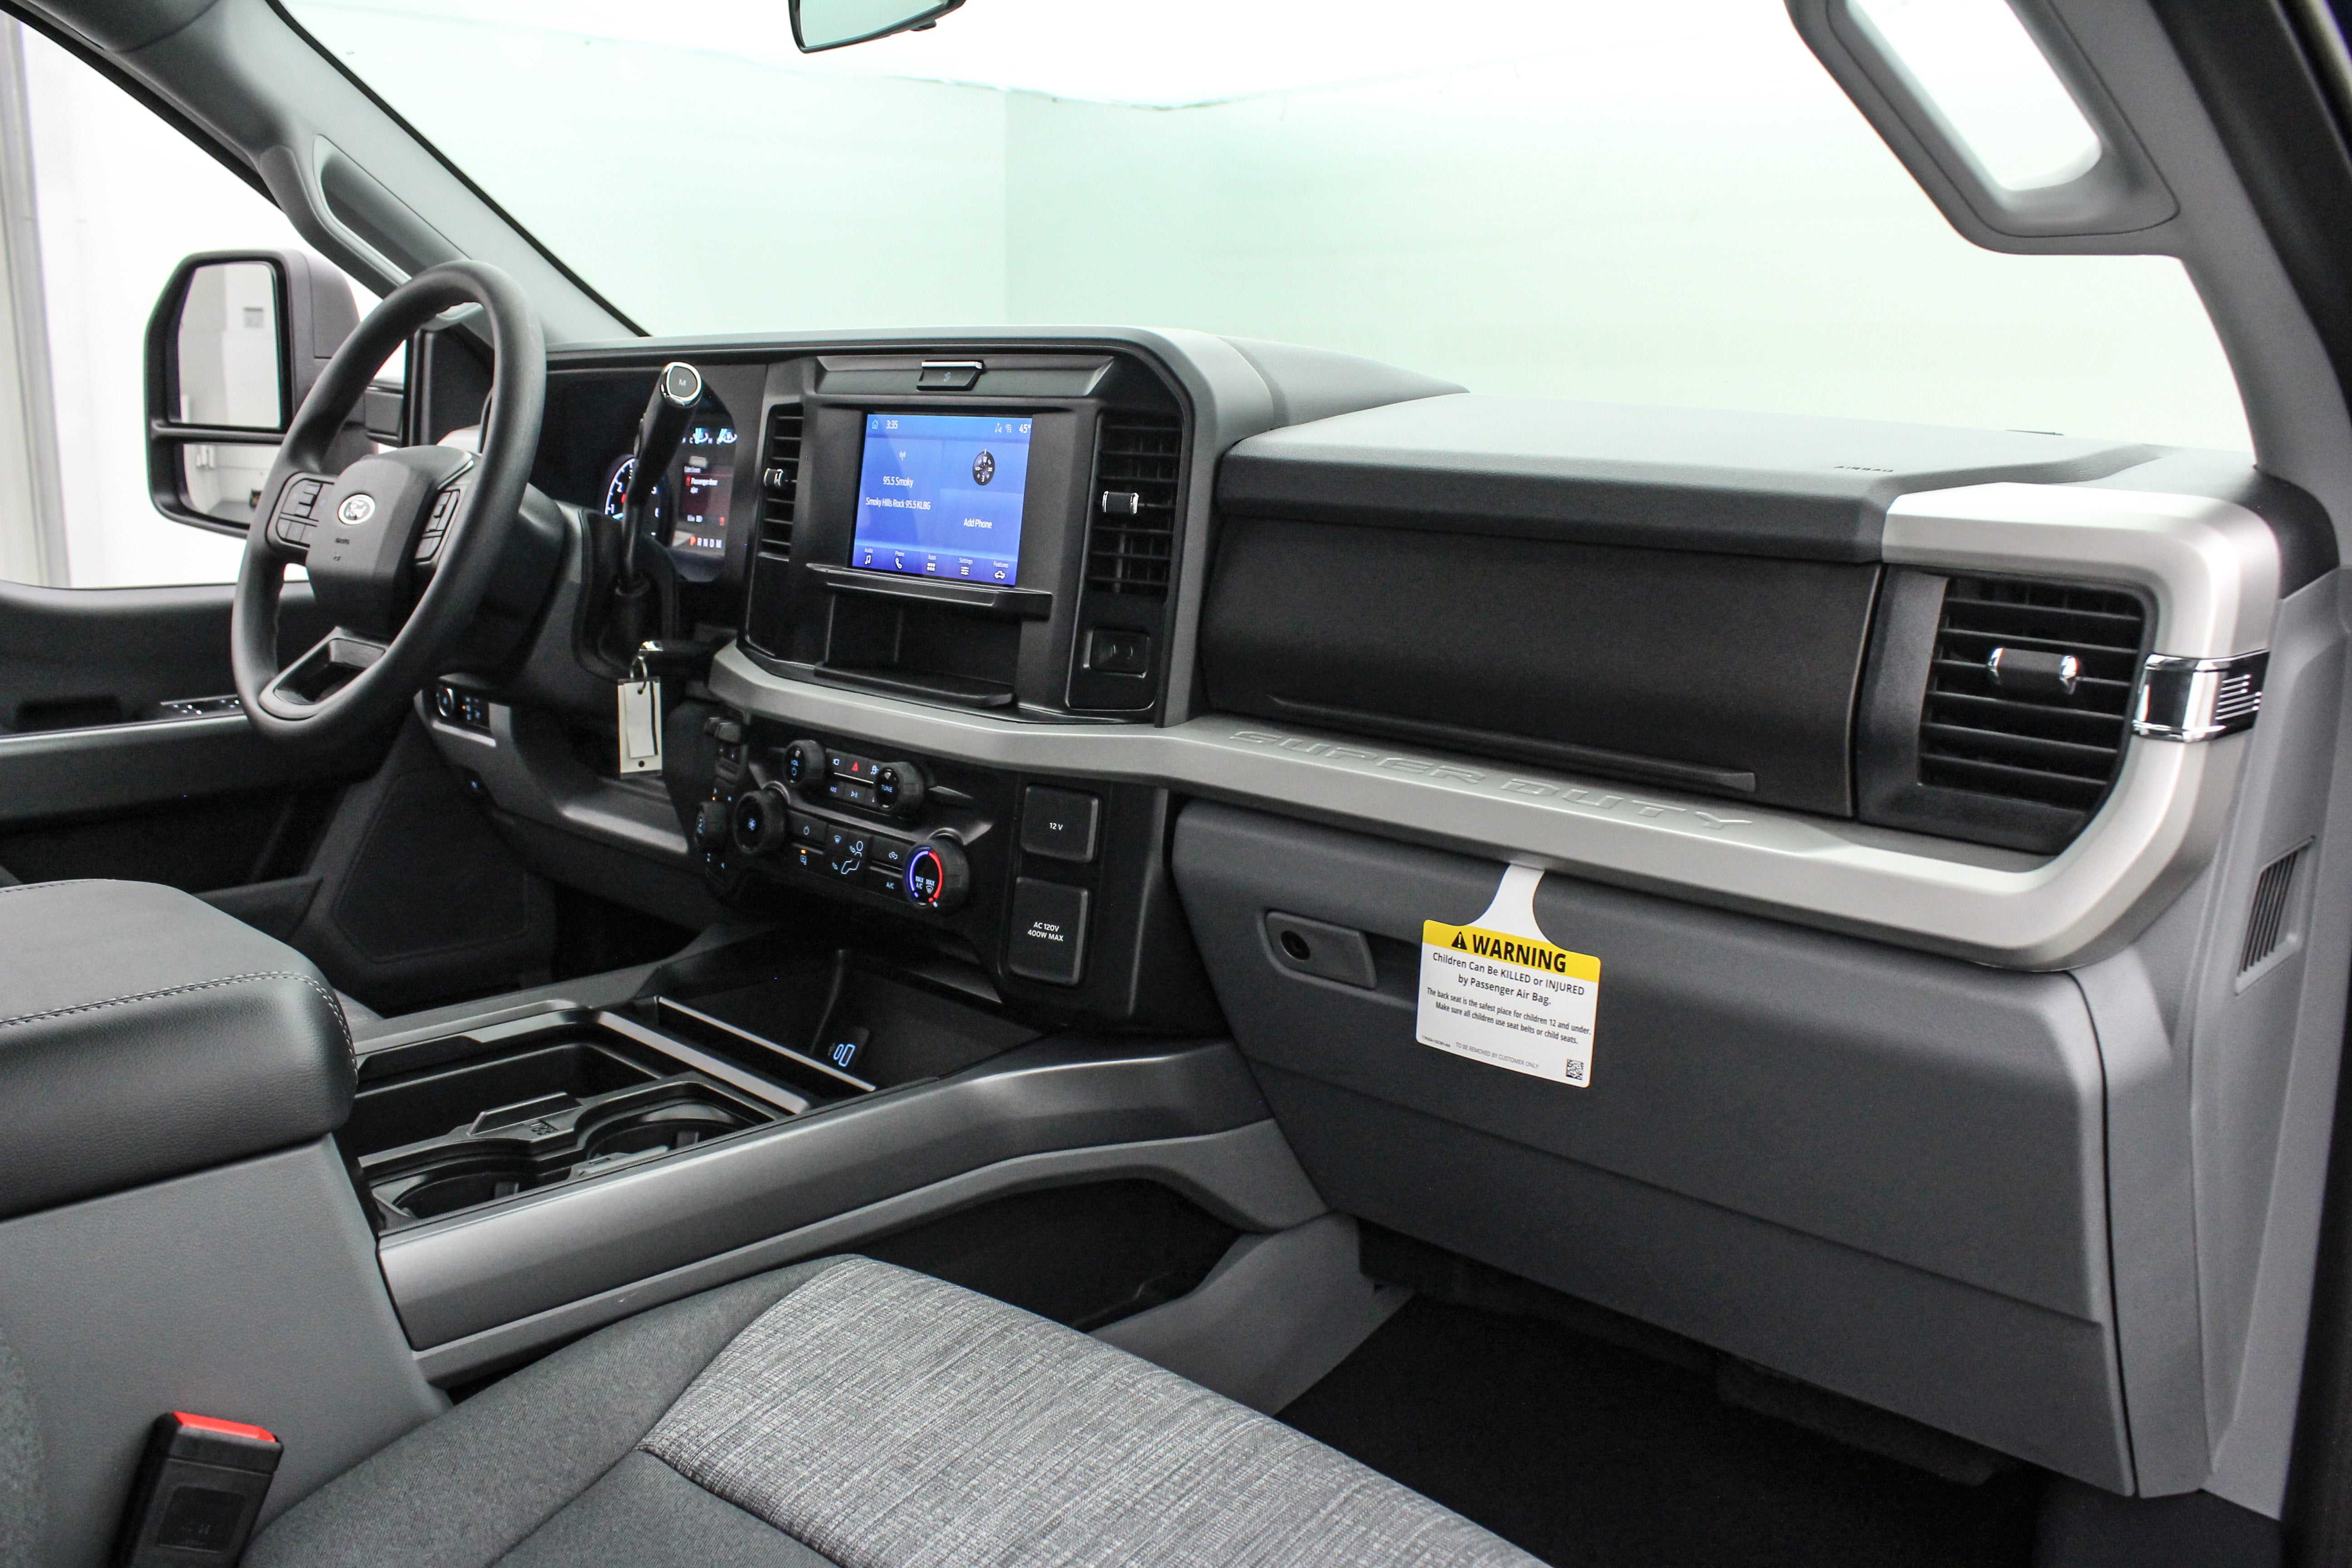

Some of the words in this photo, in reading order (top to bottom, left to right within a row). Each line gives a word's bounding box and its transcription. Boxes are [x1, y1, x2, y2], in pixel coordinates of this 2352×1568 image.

[886, 420, 898, 429] 3:35
[1019, 423, 1031, 433] 45°
[883, 476, 895, 485] 95.5
[895, 477, 914, 488] Smoky
[866, 497, 882, 507] Smoky
[882, 498, 892, 507] Hills
[893, 499, 905, 508] Rock
[905, 500, 916, 509] 95.5
[963, 518, 974, 527] Add
[975, 519, 992, 529] Phone
[959, 557, 973, 565] Settings
[1229, 731, 1487, 784] SUPER
[1500, 778, 1754, 830] DUTY
[882, 784, 892, 793] TUNE
[1044, 923, 1059, 931] 120V
[1028, 929, 1047, 938] 400W
[1049, 933, 1063, 941] MAX
[1473, 934, 1566, 973] WARNING
[1433, 952, 1466, 968] Children
[1469, 961, 1485, 972] Can
[1487, 965, 1498, 975] Be
[1500, 969, 1530, 983] KILLED
[1546, 979, 1584, 995] INJURED
[1458, 974, 1468, 986] by
[1470, 978, 1514, 995] Passenger
[1516, 989, 1529, 999] Air
[1532, 992, 1551, 1006] Bag.
[1427, 987, 1436, 996] The
[1437, 990, 1449, 1000] back
[1450, 995, 1461, 1003] seat
[1469, 999, 1477, 1007] the
[1479, 1003, 1495, 1012] safest
[1497, 1007, 1512, 1016] place
[1514, 1010, 1522, 1019] for
[1524, 1013, 1547, 1024] children
[1571, 1025, 1591, 1035] under.
[1436, 1001, 1450, 1011] Make
[1451, 1007, 1463, 1015] sure
[1472, 1012, 1494, 1024] children
[1507, 1021, 1519, 1030] seat
[1520, 1024, 1535, 1034] belts
[1544, 1030, 1559, 1039] child
[1560, 1034, 1578, 1044] seats.
[1469, 1046, 1491, 1056] REMOVED
[1499, 1054, 1524, 1065] CUSTOMER
